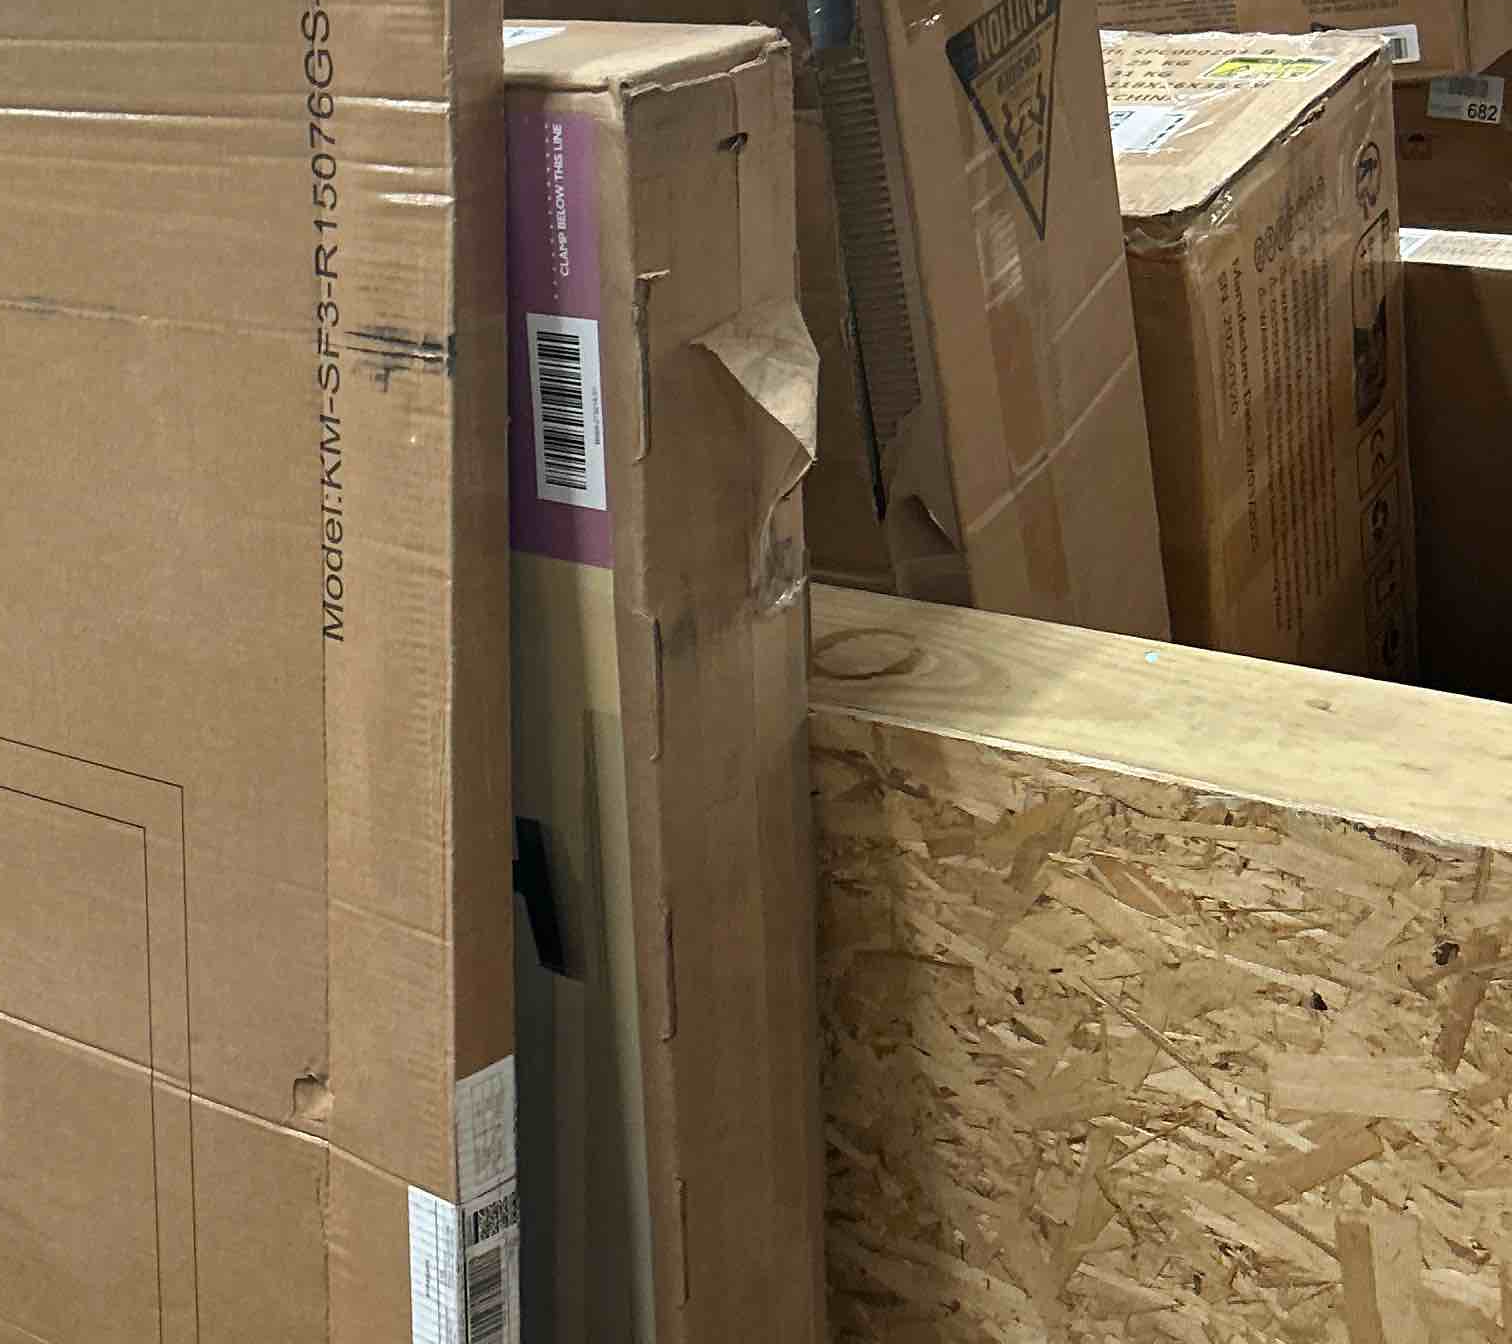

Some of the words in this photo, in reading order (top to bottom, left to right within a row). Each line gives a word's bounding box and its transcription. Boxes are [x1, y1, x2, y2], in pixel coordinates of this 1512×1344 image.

[1467, 103, 1498, 121] 682
[552, 123, 563, 151] LINE
[554, 154, 564, 181] THIS
[555, 185, 566, 230] BELOW
[559, 232, 569, 276] CLAMP
